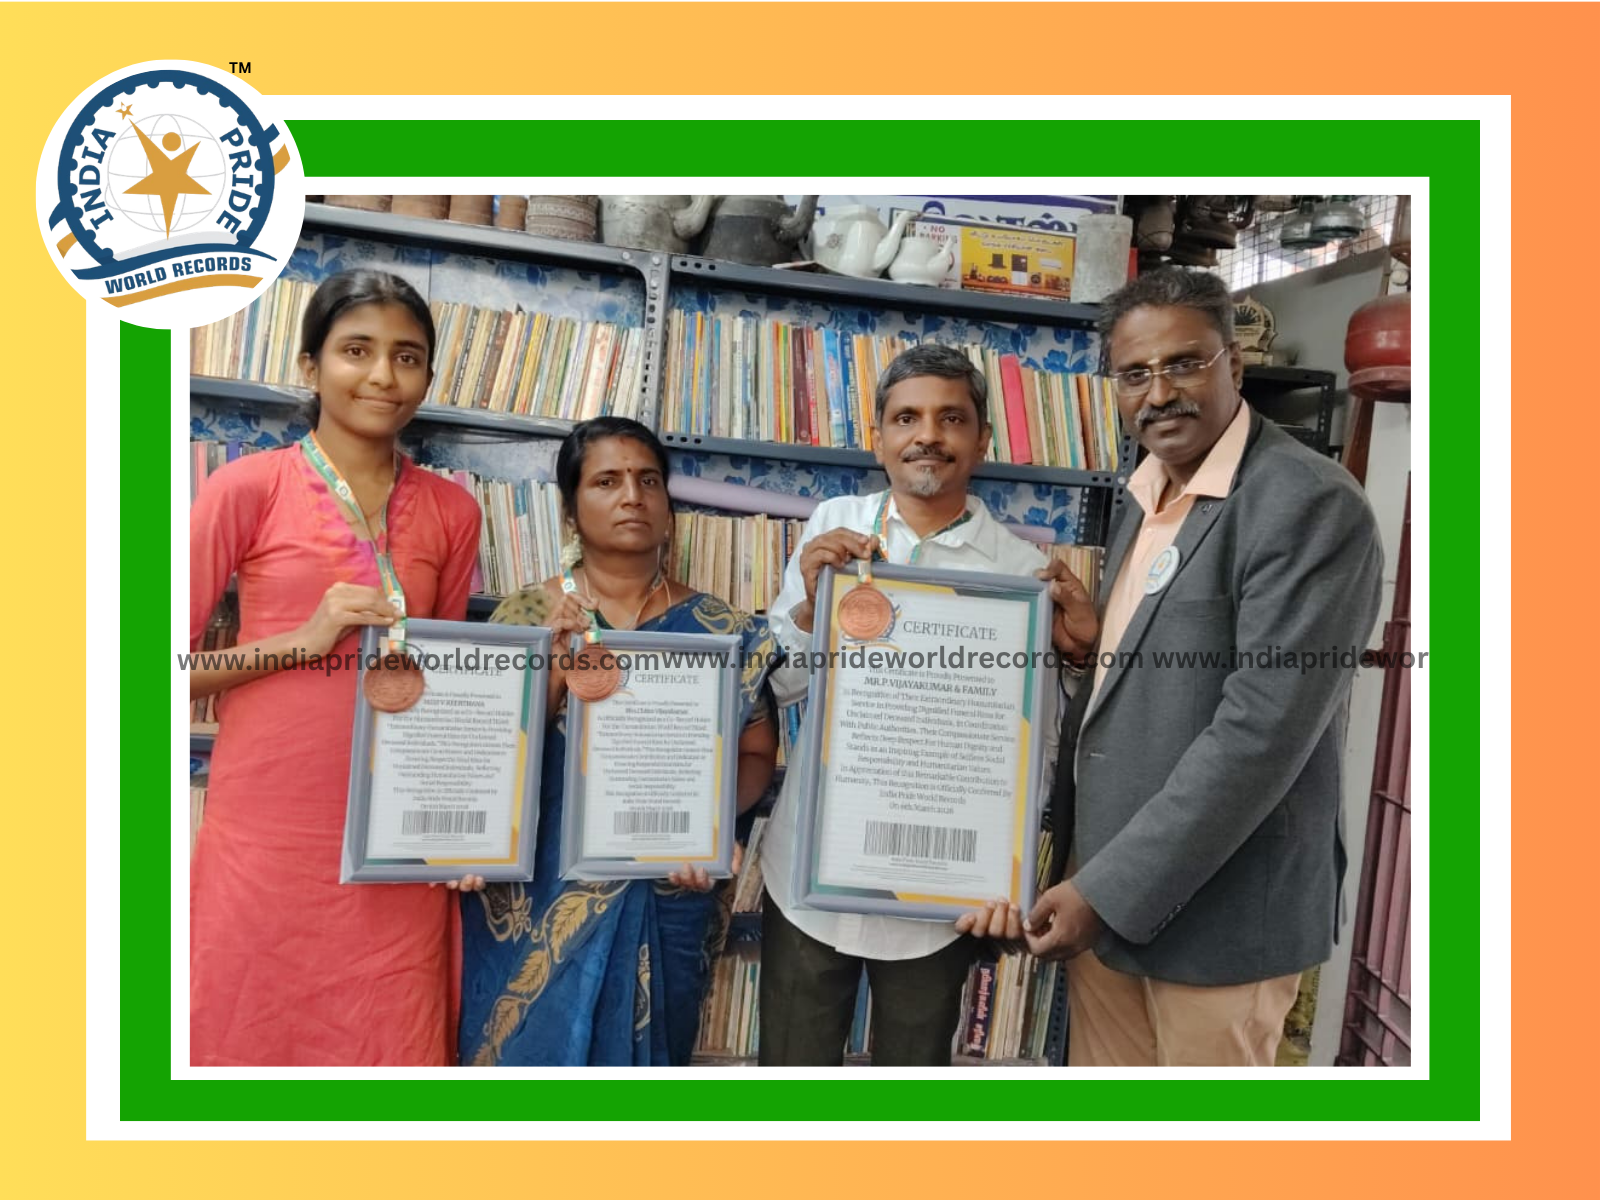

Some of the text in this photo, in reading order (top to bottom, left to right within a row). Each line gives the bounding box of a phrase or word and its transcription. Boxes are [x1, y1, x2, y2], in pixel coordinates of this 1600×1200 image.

[930, 225, 945, 233] NO
[903, 620, 998, 641] CERTIFICATE
[634, 674, 700, 684] CERTIFICATE
